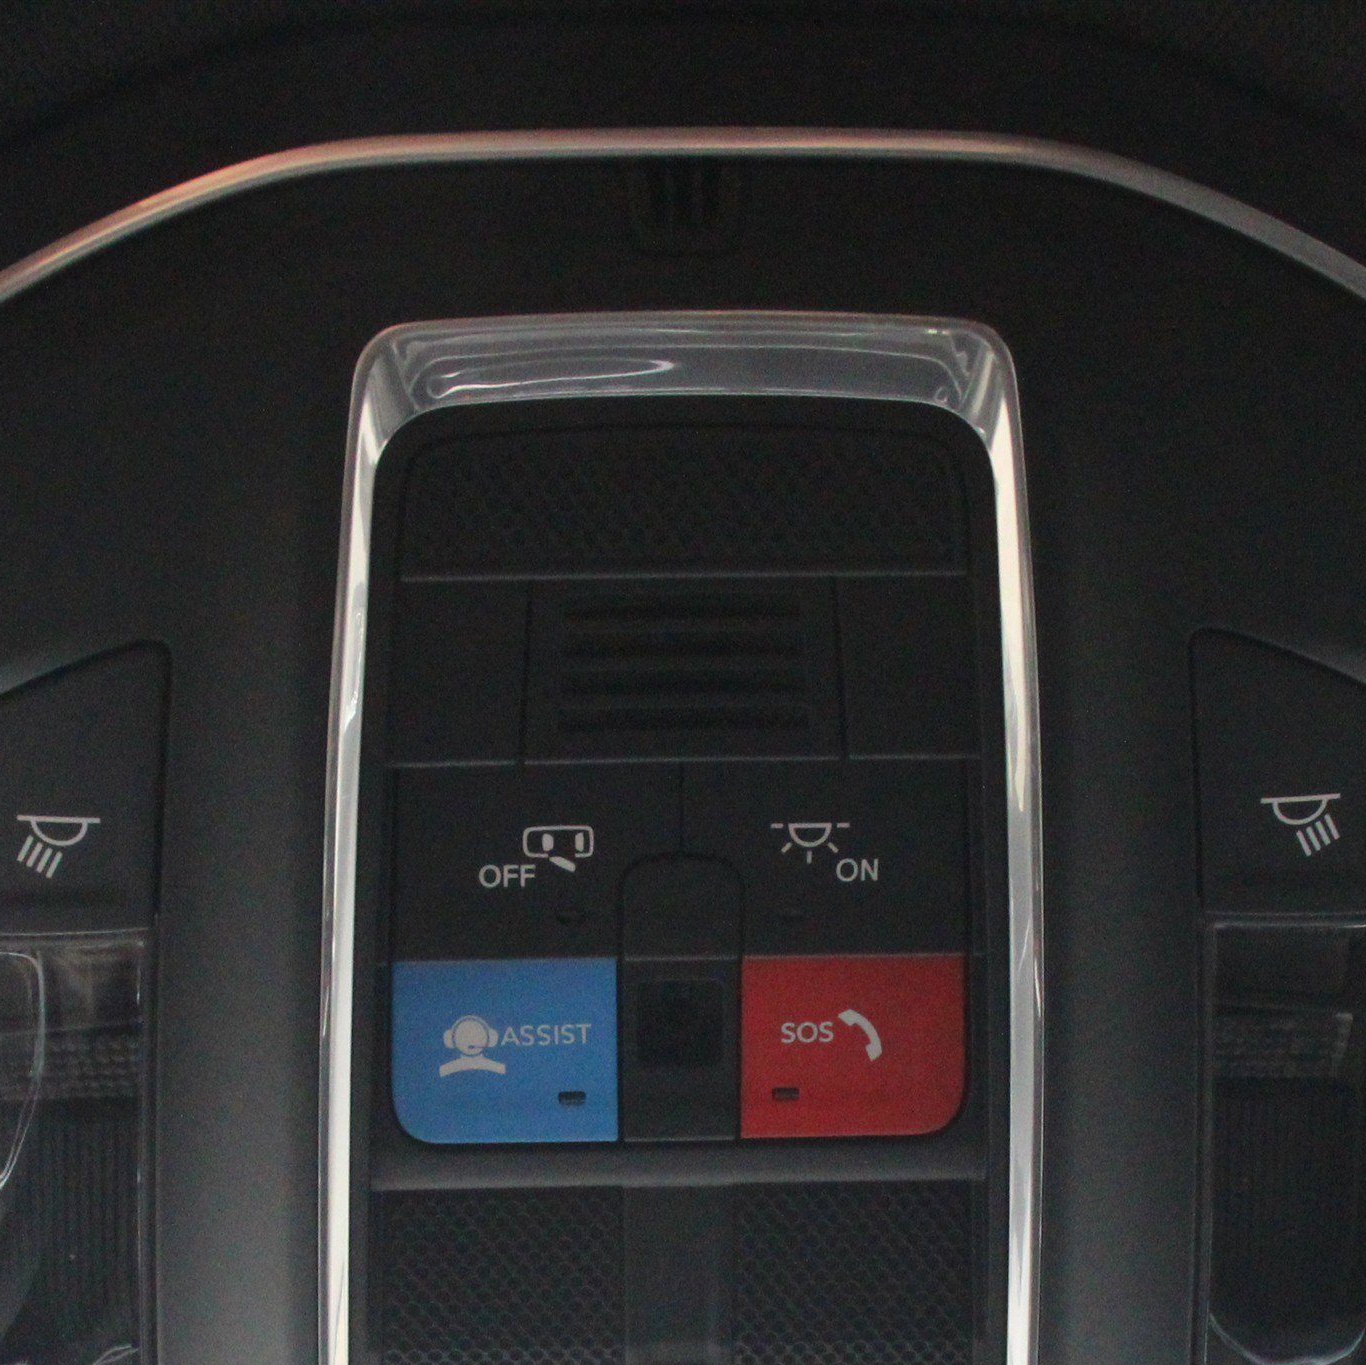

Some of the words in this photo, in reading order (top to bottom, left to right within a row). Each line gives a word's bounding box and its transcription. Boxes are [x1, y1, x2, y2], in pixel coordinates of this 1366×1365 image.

[478, 864, 536, 888] OFF
[835, 858, 879, 882] ON
[501, 1023, 591, 1046] ASSIST
[780, 1021, 834, 1043] SOS
